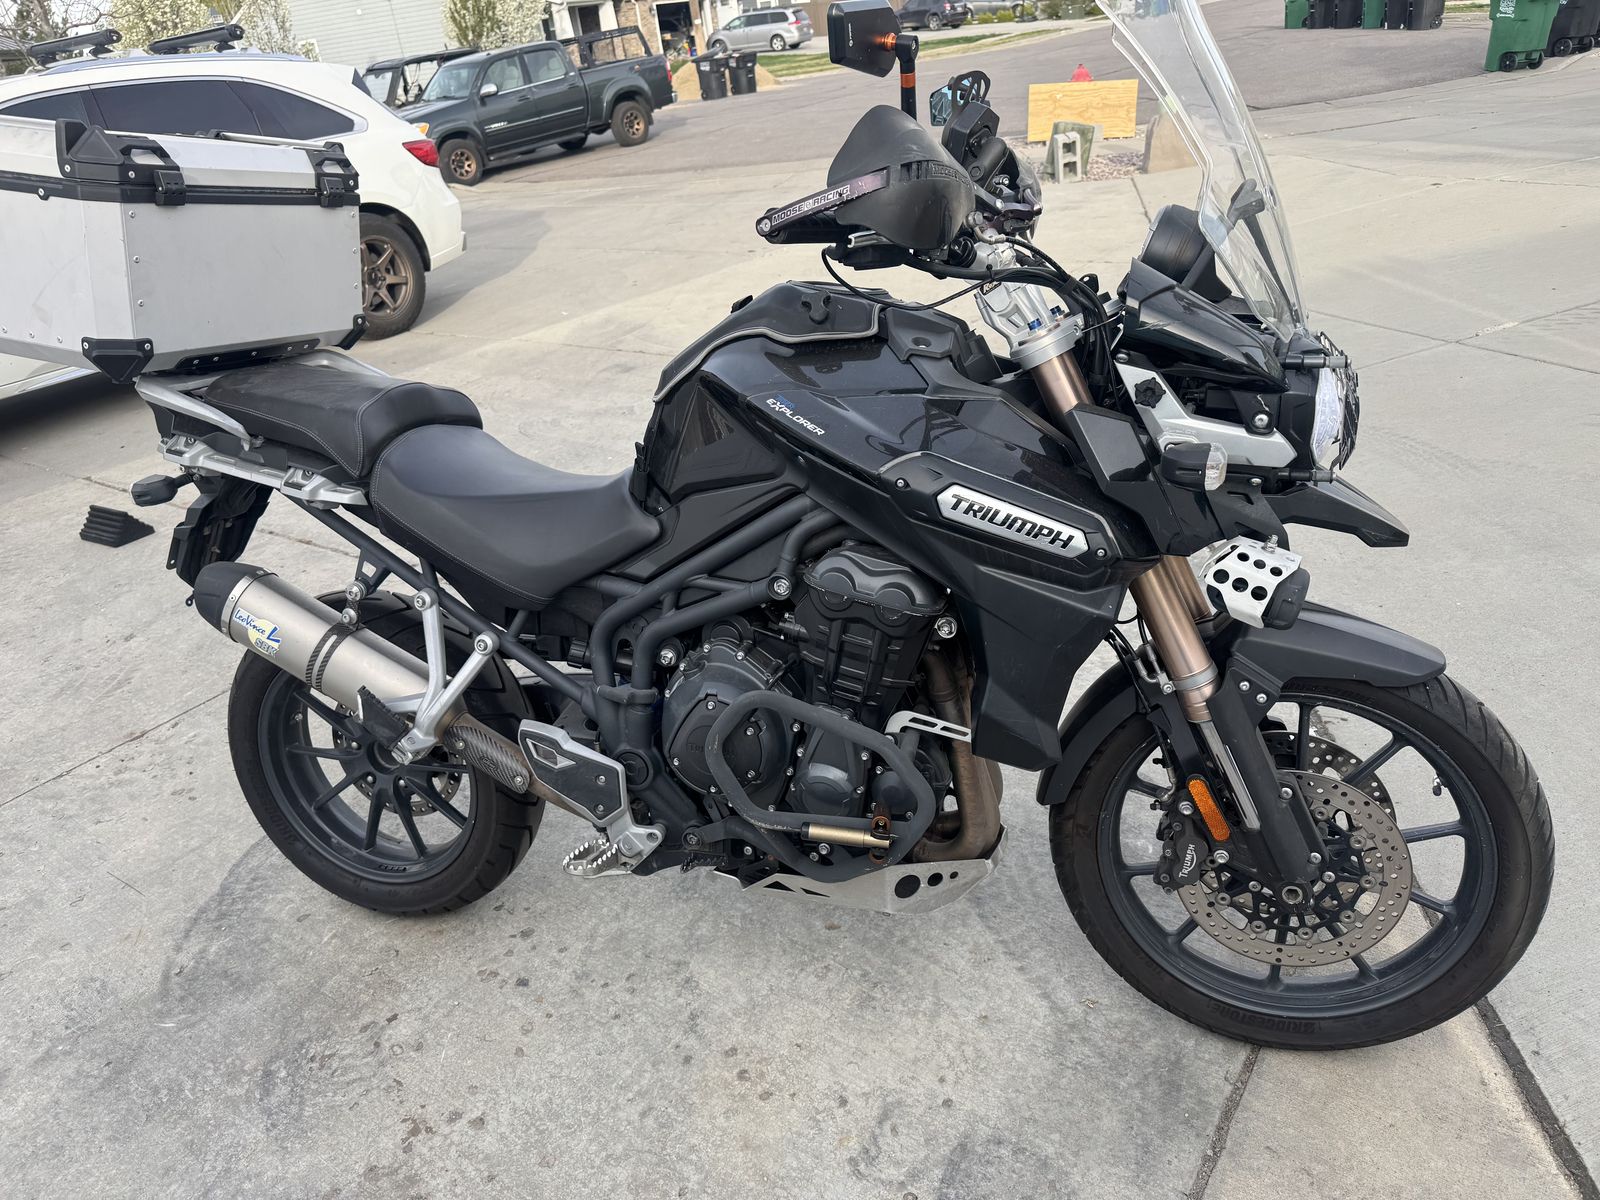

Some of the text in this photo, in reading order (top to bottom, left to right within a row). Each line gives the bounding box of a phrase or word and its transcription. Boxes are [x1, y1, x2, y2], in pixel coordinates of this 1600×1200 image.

[772, 186, 850, 225] MOOSE RACING
[766, 398, 825, 436] EXPLORER
[951, 494, 1075, 549] TRIUMPH
[235, 609, 266, 636] LeoVince
[1179, 844, 1196, 878] TRIUMPH
